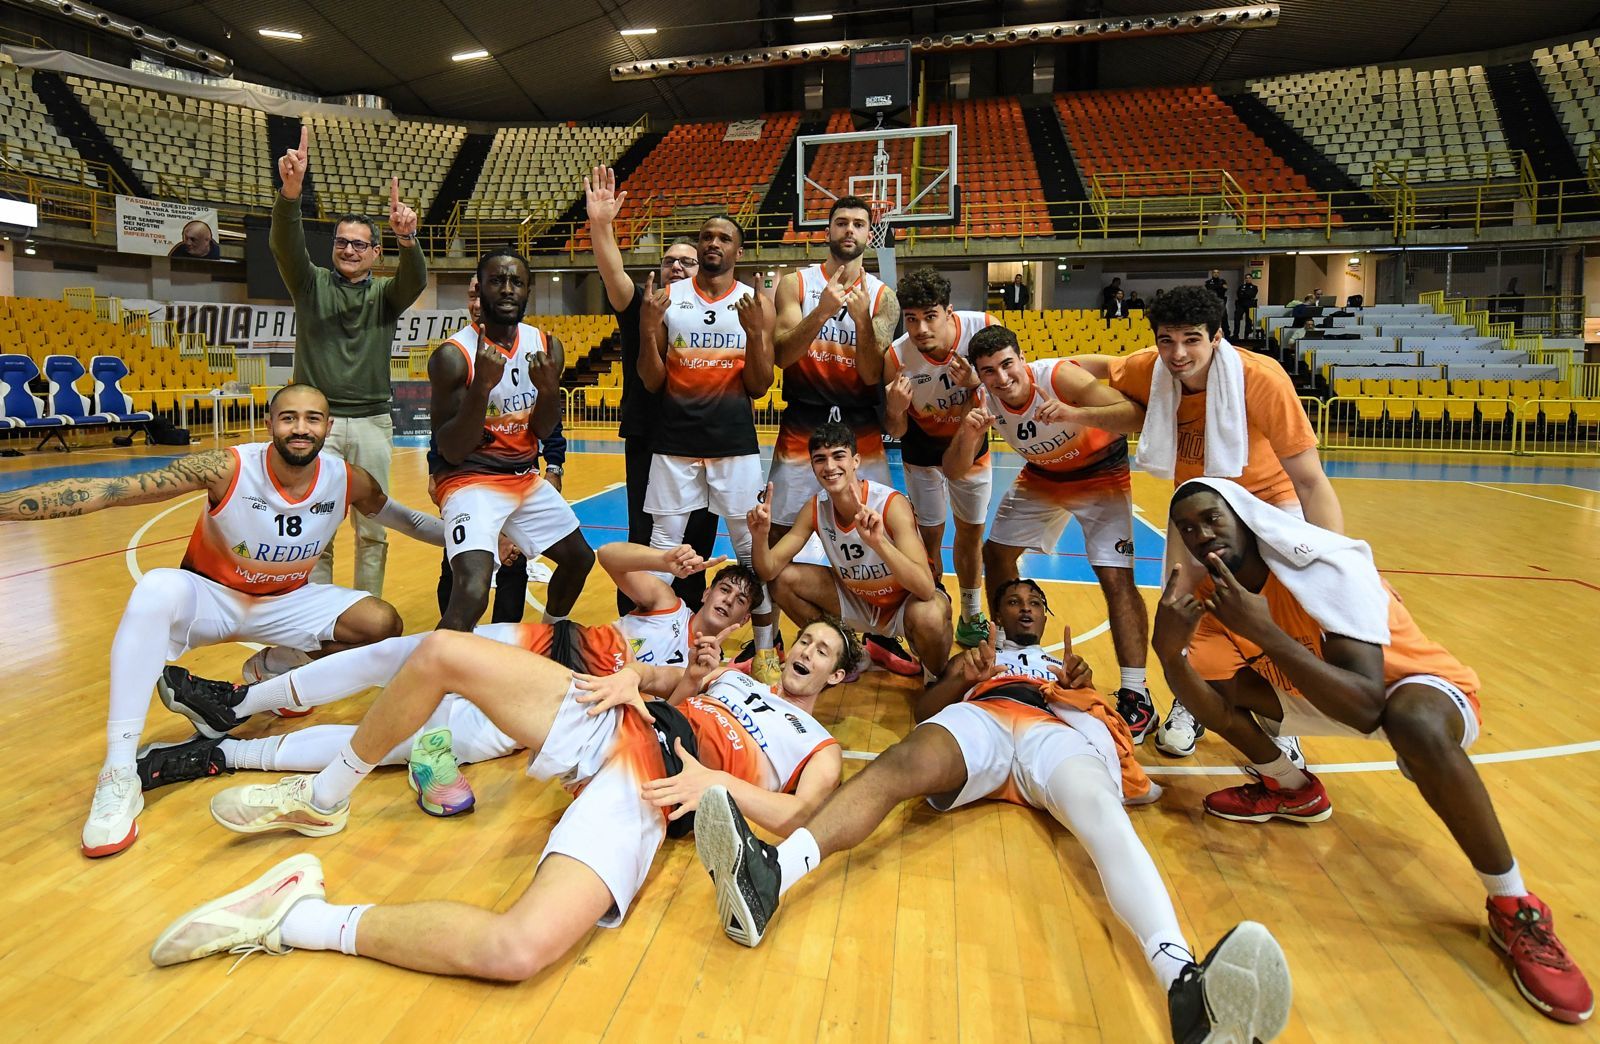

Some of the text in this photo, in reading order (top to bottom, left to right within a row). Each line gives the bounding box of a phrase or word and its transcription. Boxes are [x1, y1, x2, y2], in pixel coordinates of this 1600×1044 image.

[125, 197, 161, 207] PASQUALE
[161, 202, 187, 210] QUESTO
[138, 217, 165, 225] SEMPRE
[703, 310, 717, 326] 3
[689, 332, 746, 350] REDEL
[1016, 420, 1038, 441] 69
[274, 513, 303, 538] 18
[452, 524, 466, 545] 0
[253, 540, 323, 563] REDEL
[839, 543, 865, 561] 13
[235, 565, 308, 584] MyEnergy
[665, 649, 684, 665] 7
[1017, 653, 1029, 666] 1
